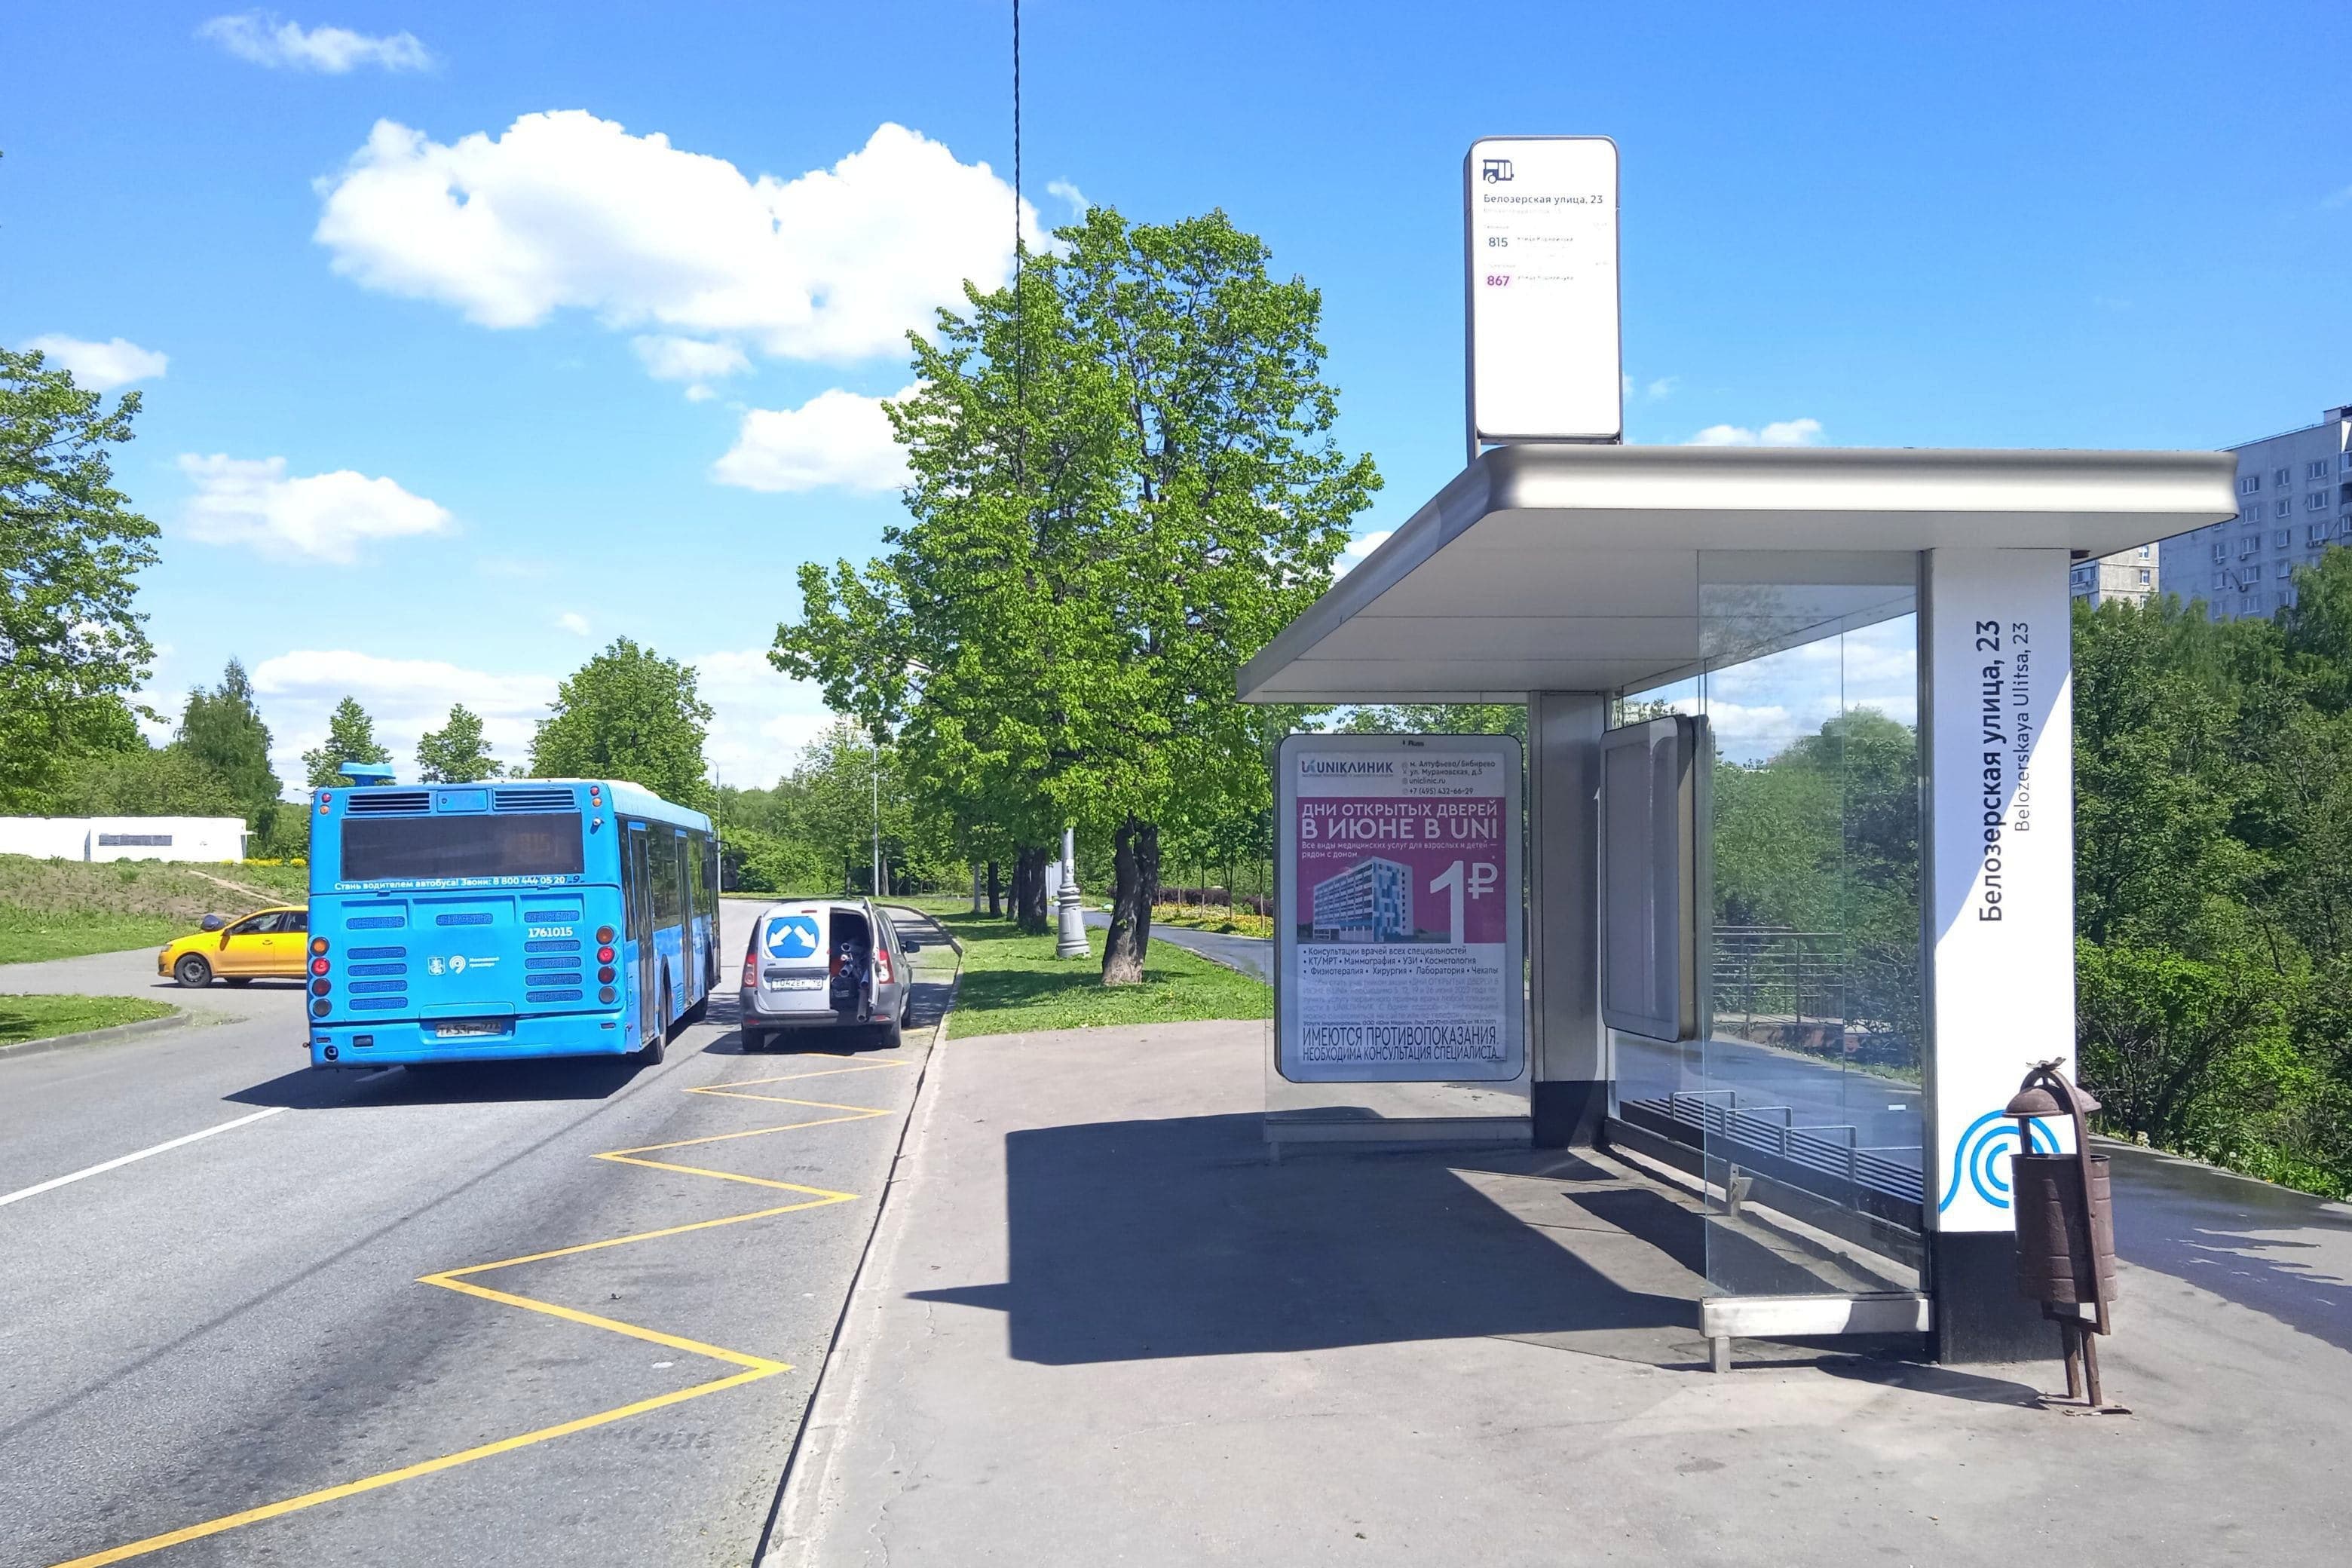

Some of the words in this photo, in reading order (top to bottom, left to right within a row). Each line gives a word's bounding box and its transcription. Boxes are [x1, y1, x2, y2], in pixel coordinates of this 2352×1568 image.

[1484, 194, 1551, 205] Белозерская
[1591, 194, 1603, 204] 23
[1488, 237, 1508, 247] 815
[1487, 275, 1510, 286] 867
[1976, 620, 2001, 653] 23
[2012, 622, 2029, 645] 23
[2012, 650, 2032, 706] Ulitsa,
[1982, 660, 2007, 746] улица,
[2012, 712, 2033, 832] Belozerskaya
[1409, 776, 1447, 785] uniclinic.ru
[1419, 787, 1436, 795] (495)
[1302, 804, 1337, 818] ДНИ
[1342, 804, 1432, 816] ОТКРЫТЫХ
[1437, 800, 1497, 818] ДВЕРЕЙ
[1302, 819, 1318, 839] В
[1328, 819, 1414, 839] ИЮНЕ
[1425, 819, 1441, 839] В
[1450, 818, 1498, 839] UNI
[1979, 752, 2007, 922] Белозерская
[334, 882, 361, 890] Стань
[363, 880, 413, 890] водителем
[415, 878, 459, 889] автобуса!
[461, 877, 492, 887] Звони:
[492, 877, 498, 885] 8
[501, 876, 519, 885] 800
[521, 876, 538, 885] 444
[540, 876, 553, 884] 05
[555, 875, 565, 884] 20
[528, 926, 573, 939] 1761015
[1308, 947, 1360, 957] Консультации
[1361, 946, 1387, 957] врачей
[1407, 946, 1467, 957] специальностей
[1308, 957, 1338, 966] КТ/МРТ
[1344, 957, 1396, 966] Маммография
[1403, 957, 1419, 965] УЗИ
[1424, 957, 1477, 965] Косметология
[1310, 966, 1364, 975] Физиотерапия
[1372, 966, 1407, 976] Хирургия
[1416, 966, 1465, 975] Лаборатория
[1472, 966, 1499, 975] Чекапы
[1303, 1027, 1362, 1046] ИМЕЮТСЯ
[1303, 1046, 1362, 1063] НЕОБХОДИМА
[1364, 1046, 1432, 1063] КОНСУЛЬТАЦИЯ
